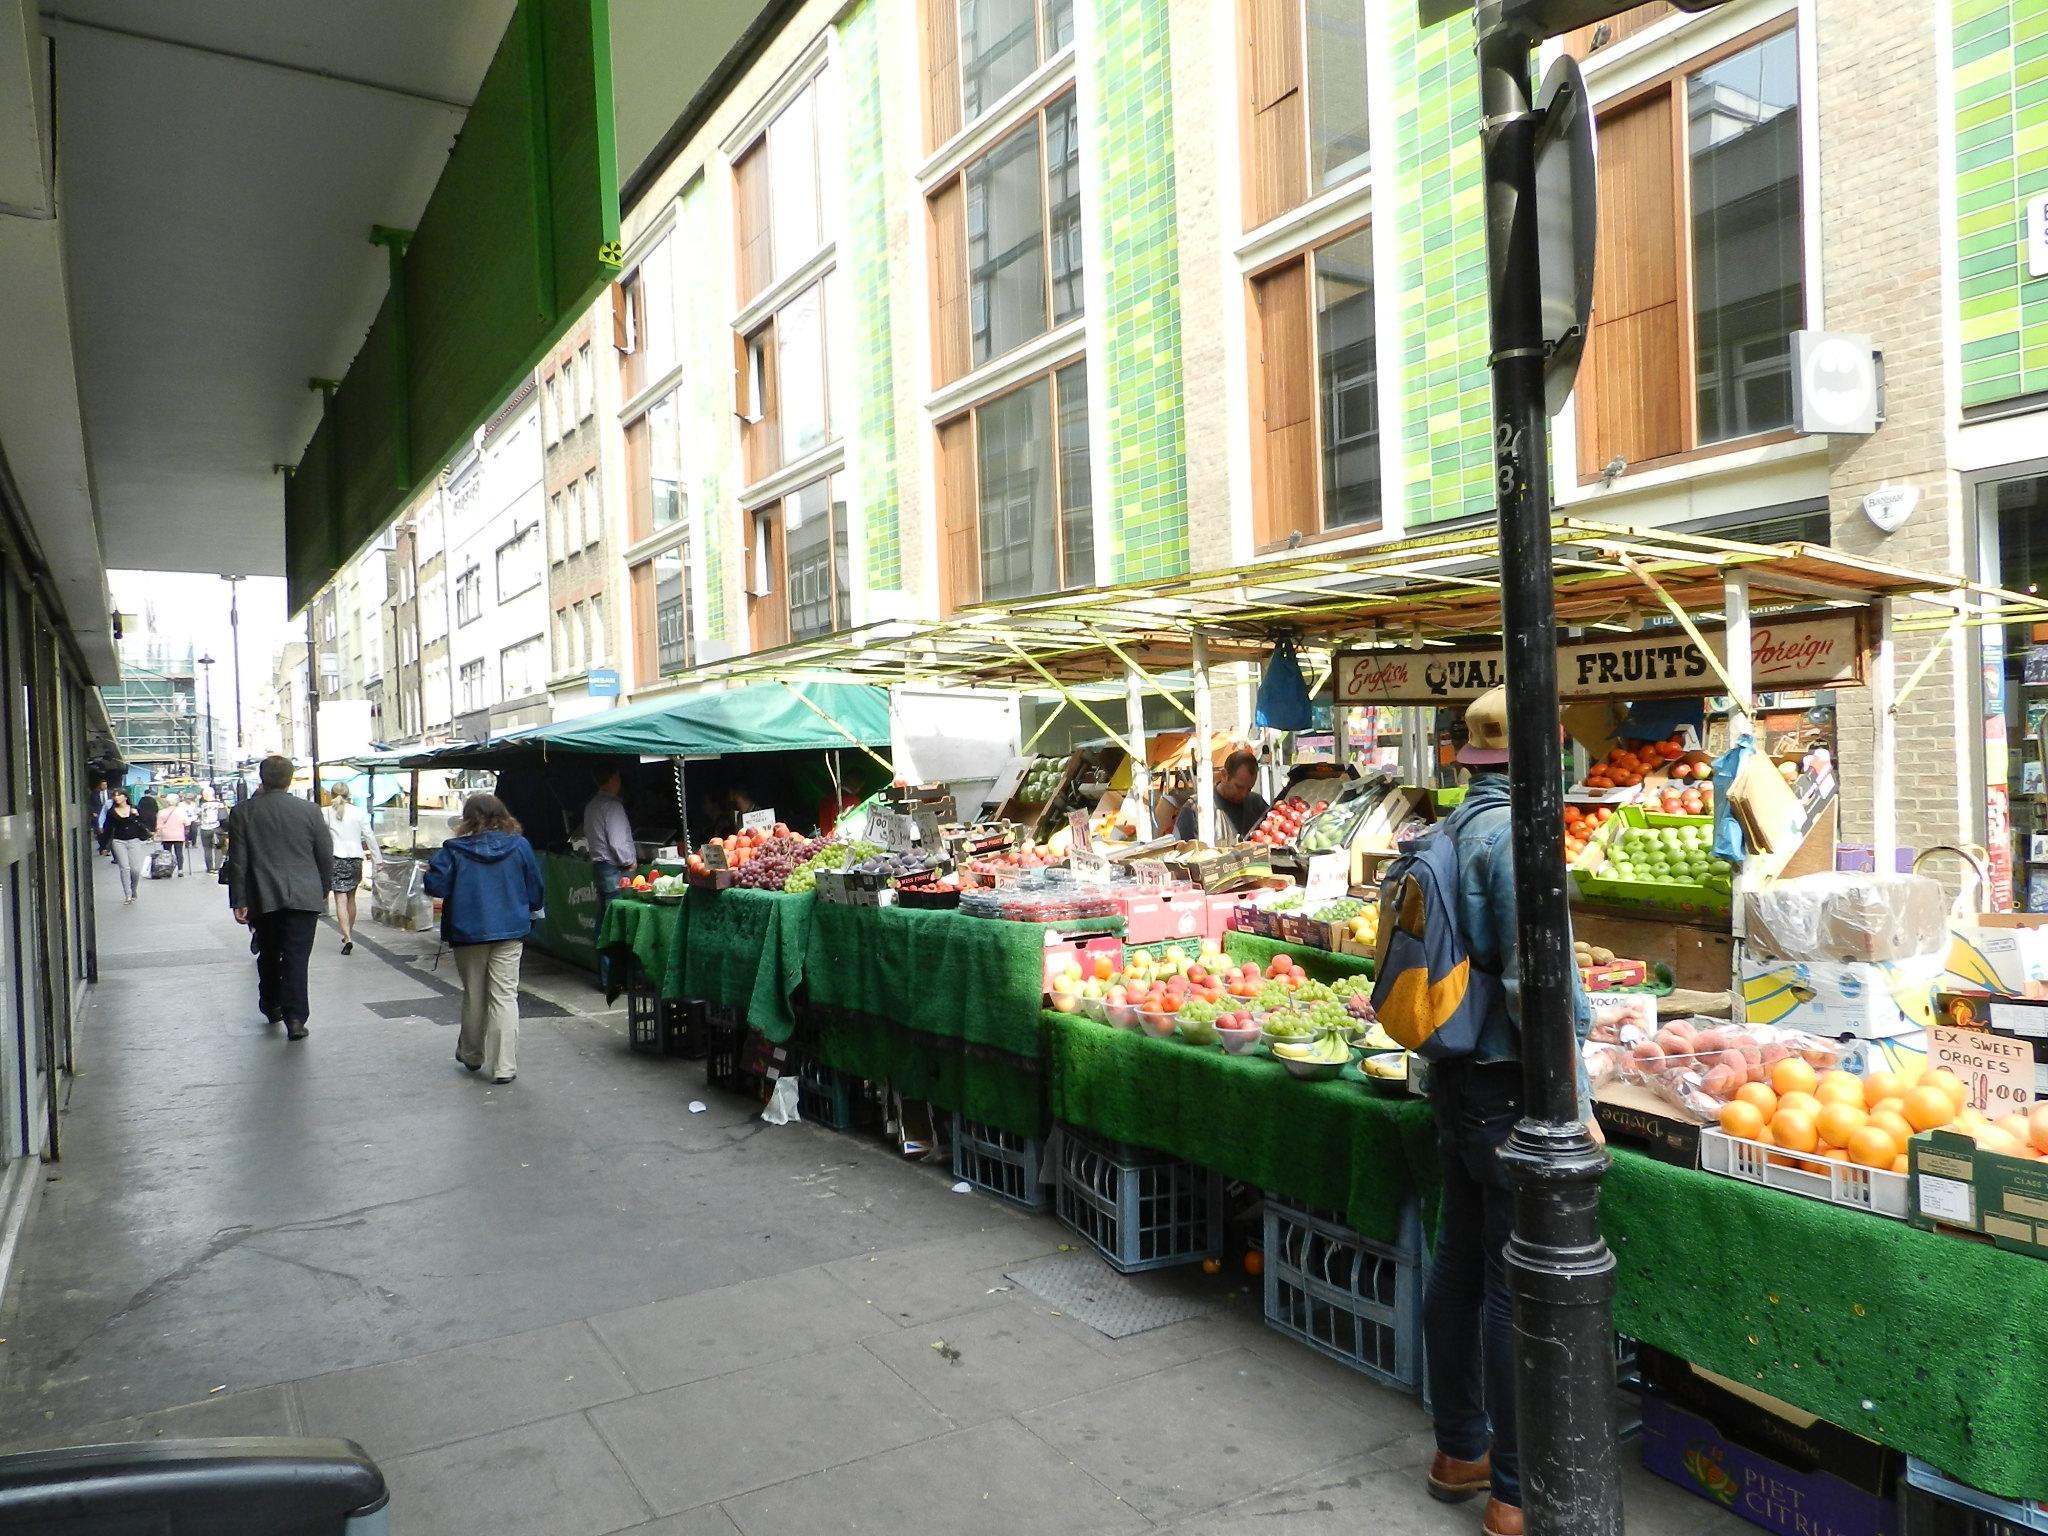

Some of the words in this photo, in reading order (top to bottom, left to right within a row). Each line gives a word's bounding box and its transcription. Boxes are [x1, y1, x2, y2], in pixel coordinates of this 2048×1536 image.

[1576, 644, 1708, 685] FRUITS
[1751, 629, 1835, 669] Foreign
[1347, 658, 1409, 695] English
[1425, 660, 1504, 696] QUAL
[1934, 1029, 1960, 1044] EX
[1970, 1037, 2024, 1057] SWEET
[1939, 1049, 2010, 1073] ORAGES
[1601, 1107, 1664, 1138] Divine
[1744, 1467, 1806, 1508] PIET
[1745, 1491, 1845, 1536] CITRU
